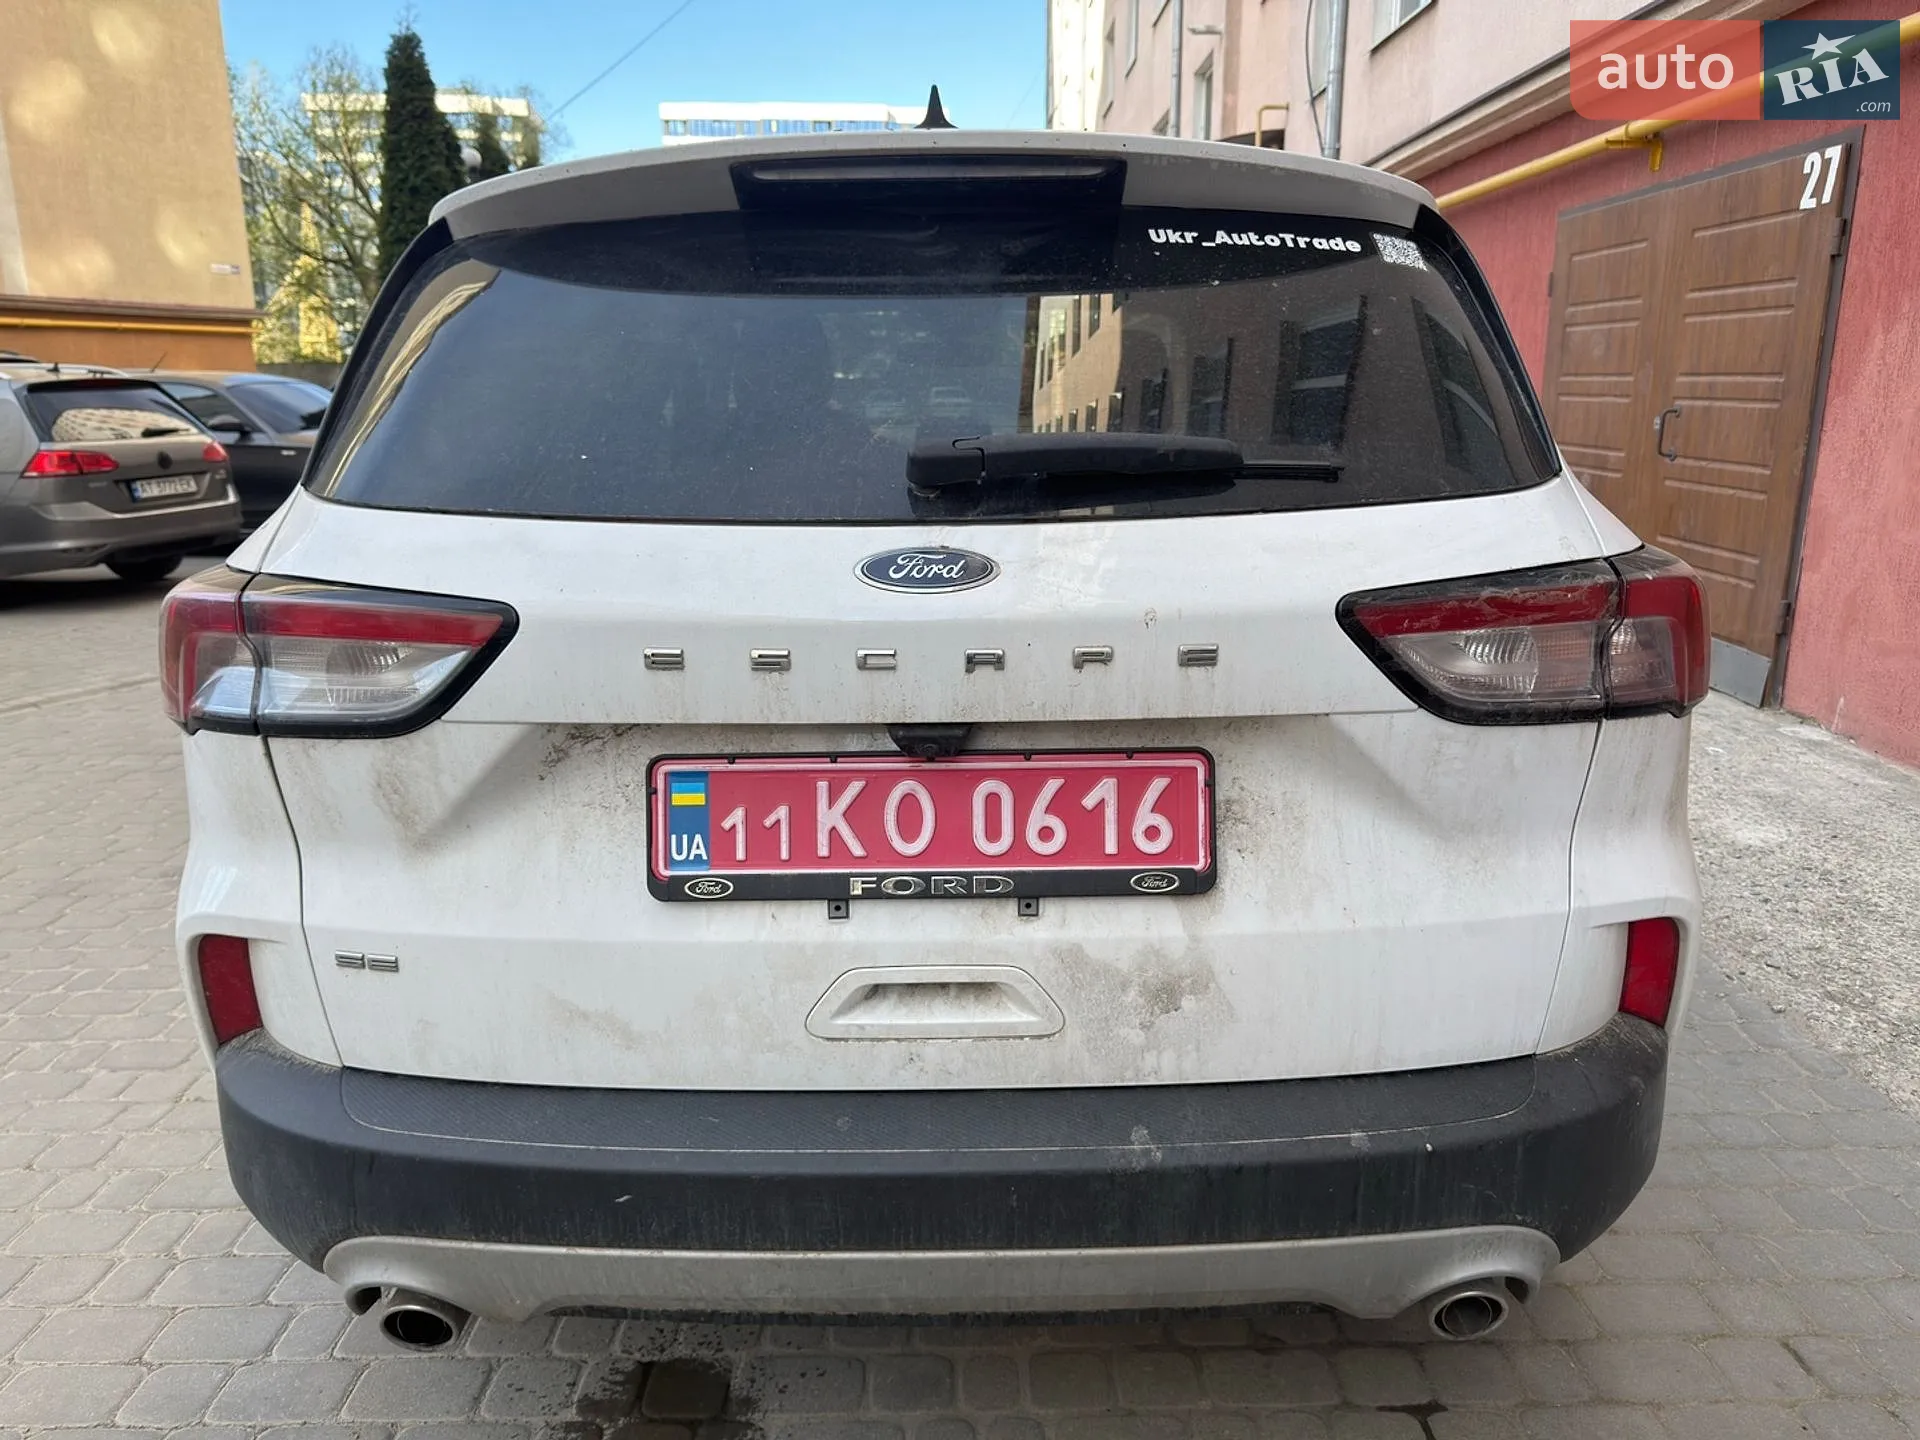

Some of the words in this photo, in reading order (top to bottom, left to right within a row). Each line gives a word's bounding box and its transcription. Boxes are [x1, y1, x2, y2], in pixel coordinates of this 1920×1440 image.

[1799, 144, 1843, 211] 27
[887, 552, 966, 579] Ford
[643, 643, 1220, 672] ESCAPE
[971, 776, 1175, 857] 0616
[670, 833, 709, 862] UA
[695, 881, 722, 894] Ford
[849, 875, 1016, 896] FORD
[1141, 875, 1168, 888] Ford
[334, 949, 400, 973] SE
